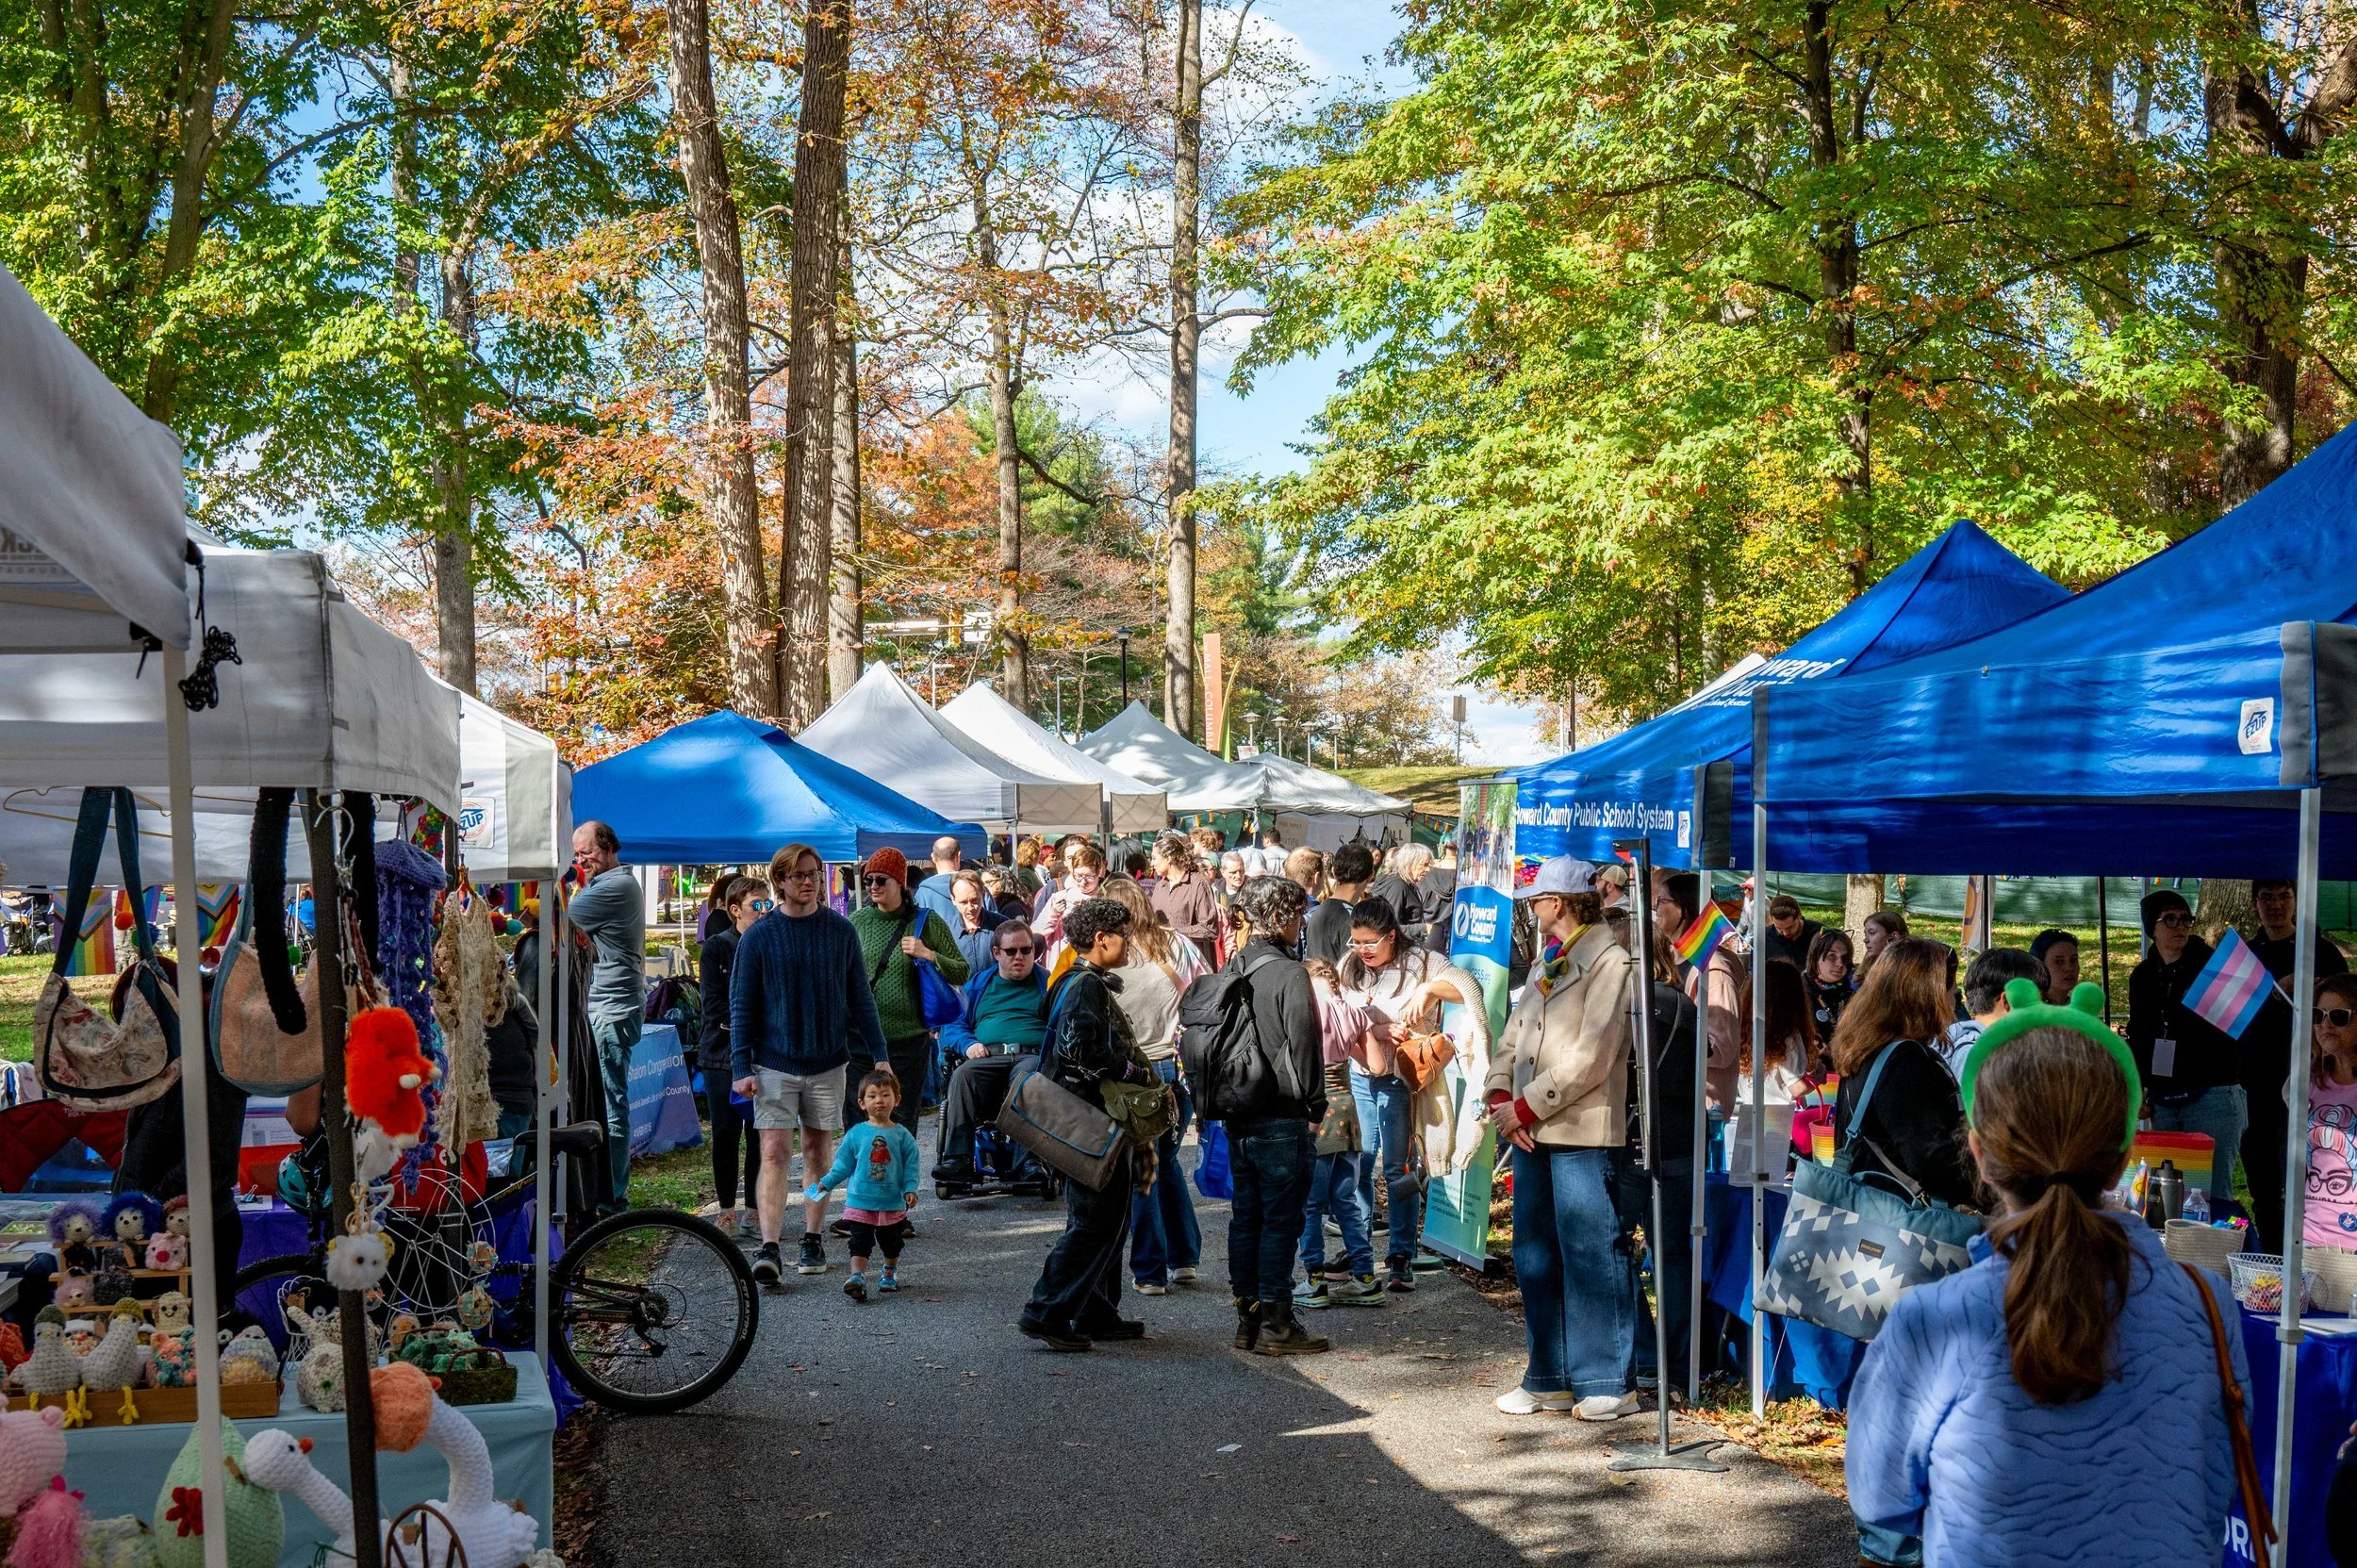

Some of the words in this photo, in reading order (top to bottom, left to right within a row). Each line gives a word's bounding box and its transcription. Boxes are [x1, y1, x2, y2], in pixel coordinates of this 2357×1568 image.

[1204, 653, 1212, 680] MALL
[1205, 691, 1214, 750] COLUMBIA
[1514, 801, 1542, 826] Howard
[1543, 801, 1573, 834] County
[1573, 801, 1601, 828] Public
[1602, 801, 1636, 829] School
[1637, 801, 1674, 835] System
[1469, 902, 1498, 922] Howard
[1470, 917, 1497, 941] County
[666, 1084, 690, 1096] County
